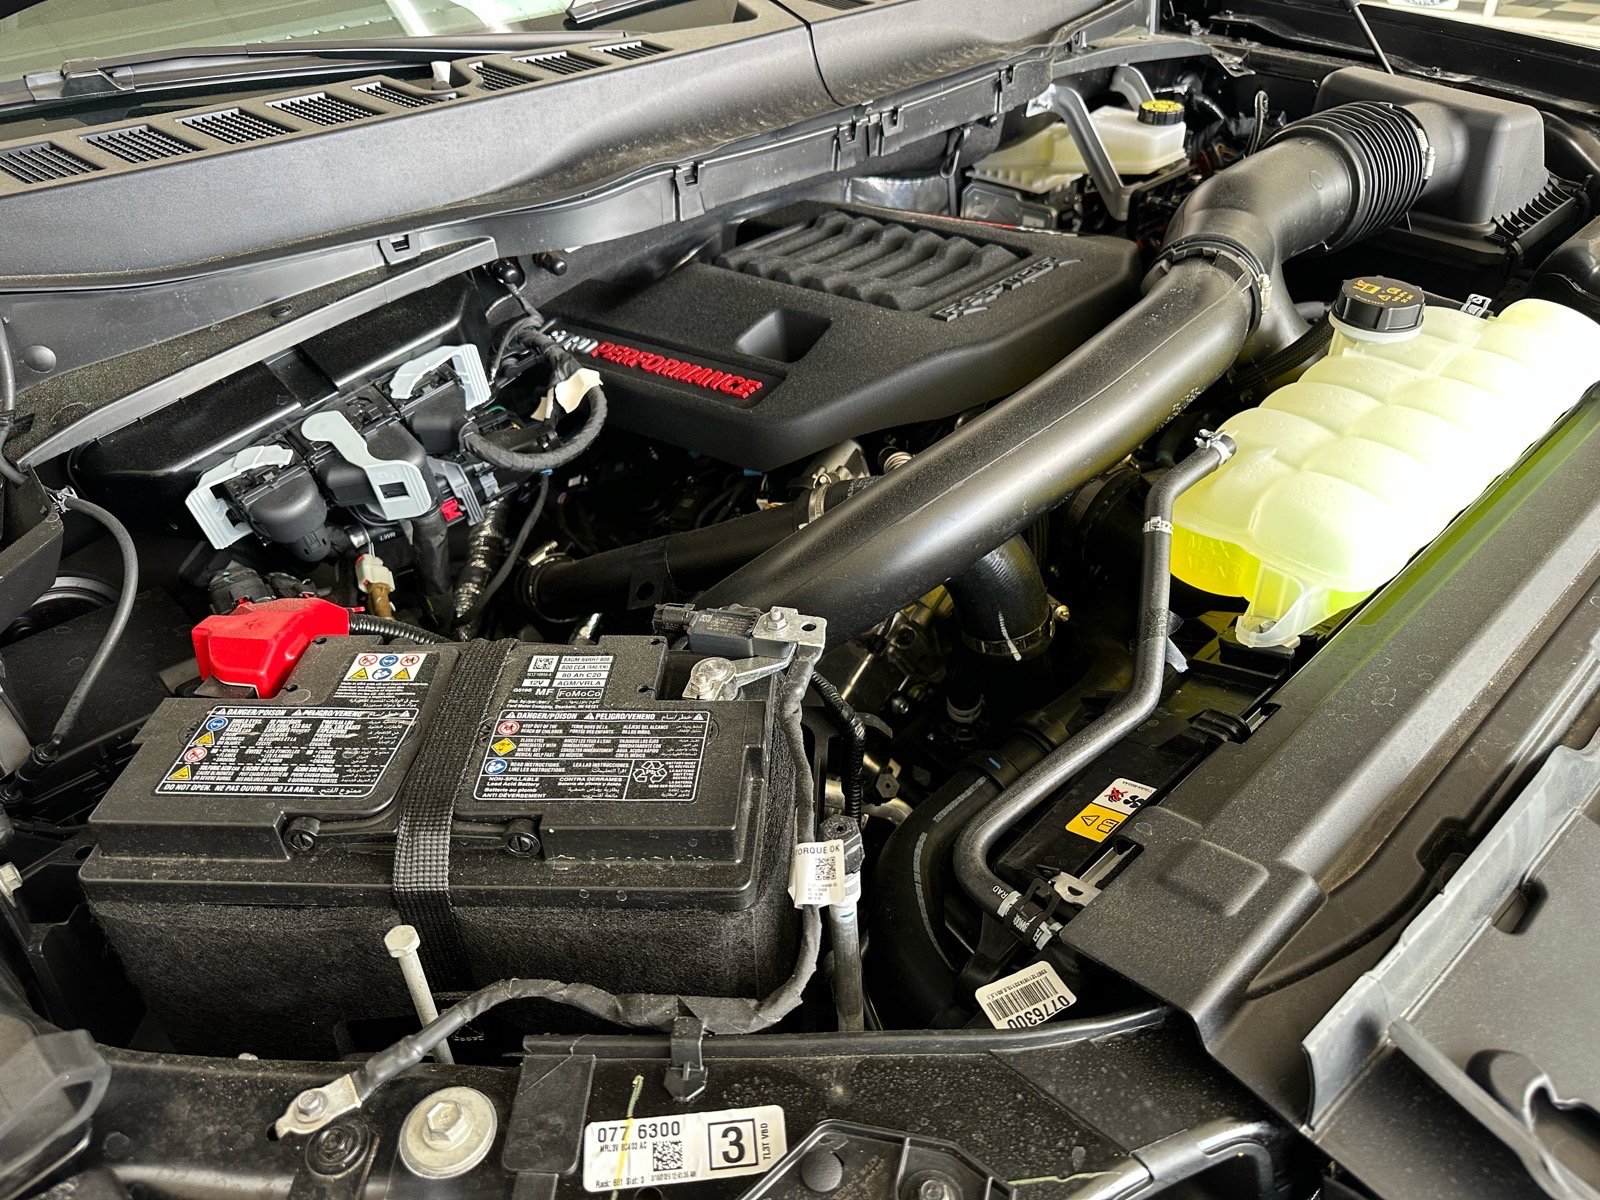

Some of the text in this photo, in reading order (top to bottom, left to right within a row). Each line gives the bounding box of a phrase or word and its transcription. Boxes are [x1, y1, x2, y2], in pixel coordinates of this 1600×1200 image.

[591, 341, 763, 399] PERFORMANCE
[380, 531, 396, 541] LWR
[595, 712, 656, 720] PELIGRO/VENENO
[829, 844, 841, 853] OK
[992, 885, 1009, 899] RAD
[598, 1121, 680, 1143] 077 6300
[722, 1126, 746, 1163] 3
